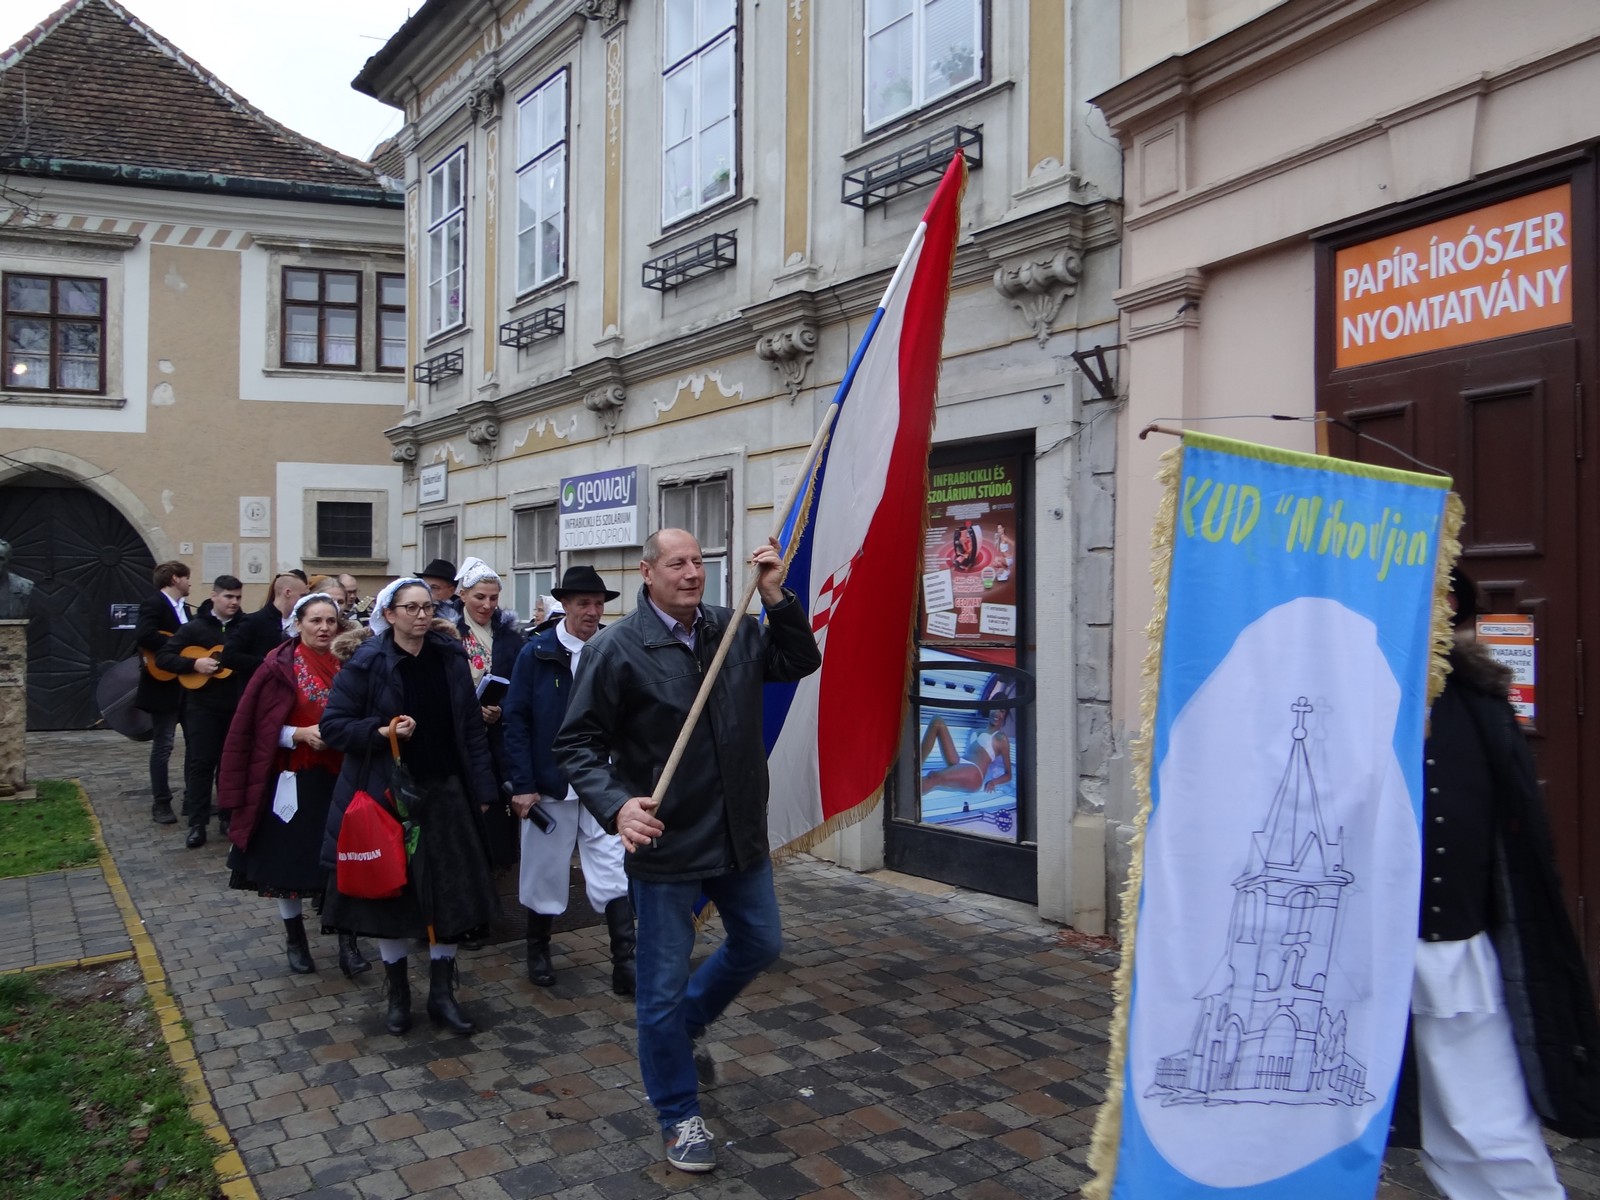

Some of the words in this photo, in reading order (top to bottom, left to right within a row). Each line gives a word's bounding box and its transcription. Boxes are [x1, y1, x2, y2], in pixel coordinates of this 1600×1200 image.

[1343, 211, 1567, 301] PAPÍR-ÍRÓSZER
[1342, 264, 1569, 349] NYOMTATVÁNY
[927, 487, 977, 503] SZOLÁRIUM
[978, 480, 1012, 498] STÚDIÓ
[934, 469, 992, 487] INFRABICIKLI
[994, 466, 1005, 480] ÉS
[1183, 476, 1262, 545] KUD
[564, 529, 594, 547] STÚDIÓ
[595, 527, 631, 545] SOPRON
